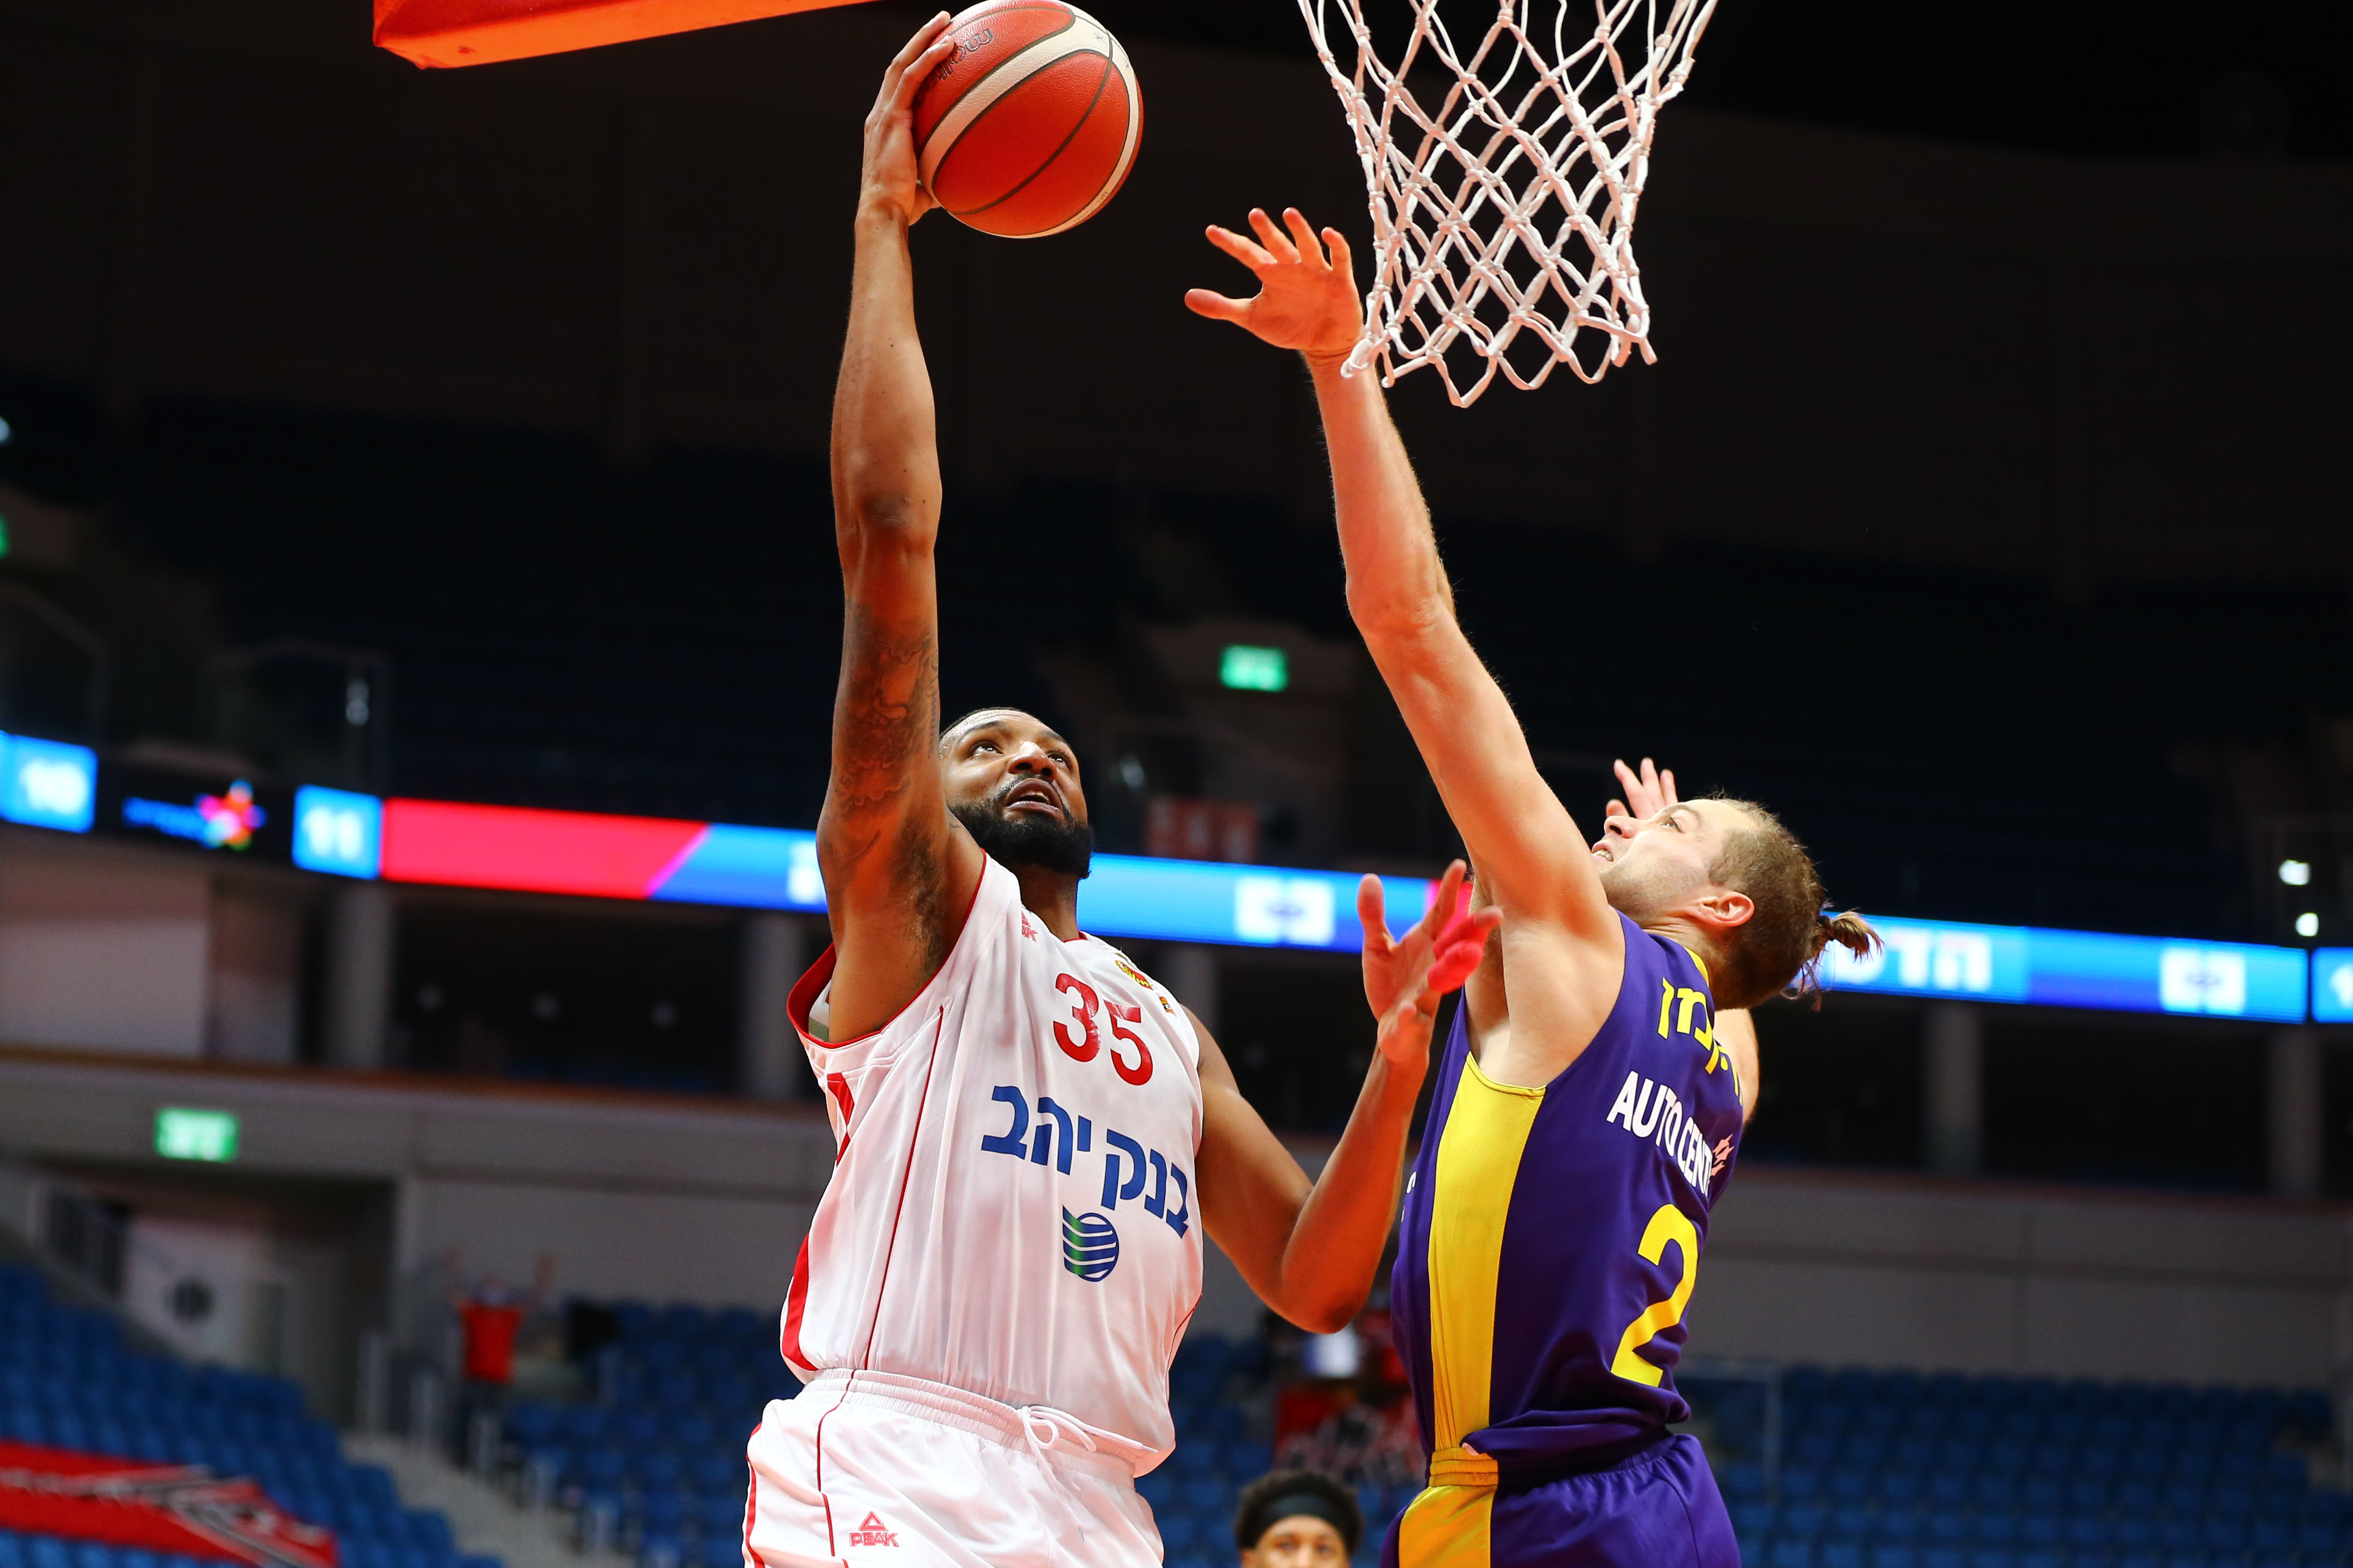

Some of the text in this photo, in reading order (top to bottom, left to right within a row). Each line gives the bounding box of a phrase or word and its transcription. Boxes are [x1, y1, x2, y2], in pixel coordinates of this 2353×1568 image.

[1053, 973, 1153, 1086] 35
[981, 1085, 1189, 1240] בנק יהב
[1606, 1070, 1713, 1199] AUTO CENT
[1611, 1203, 1699, 1388] 2
[849, 1532, 899, 1547] PEAK
